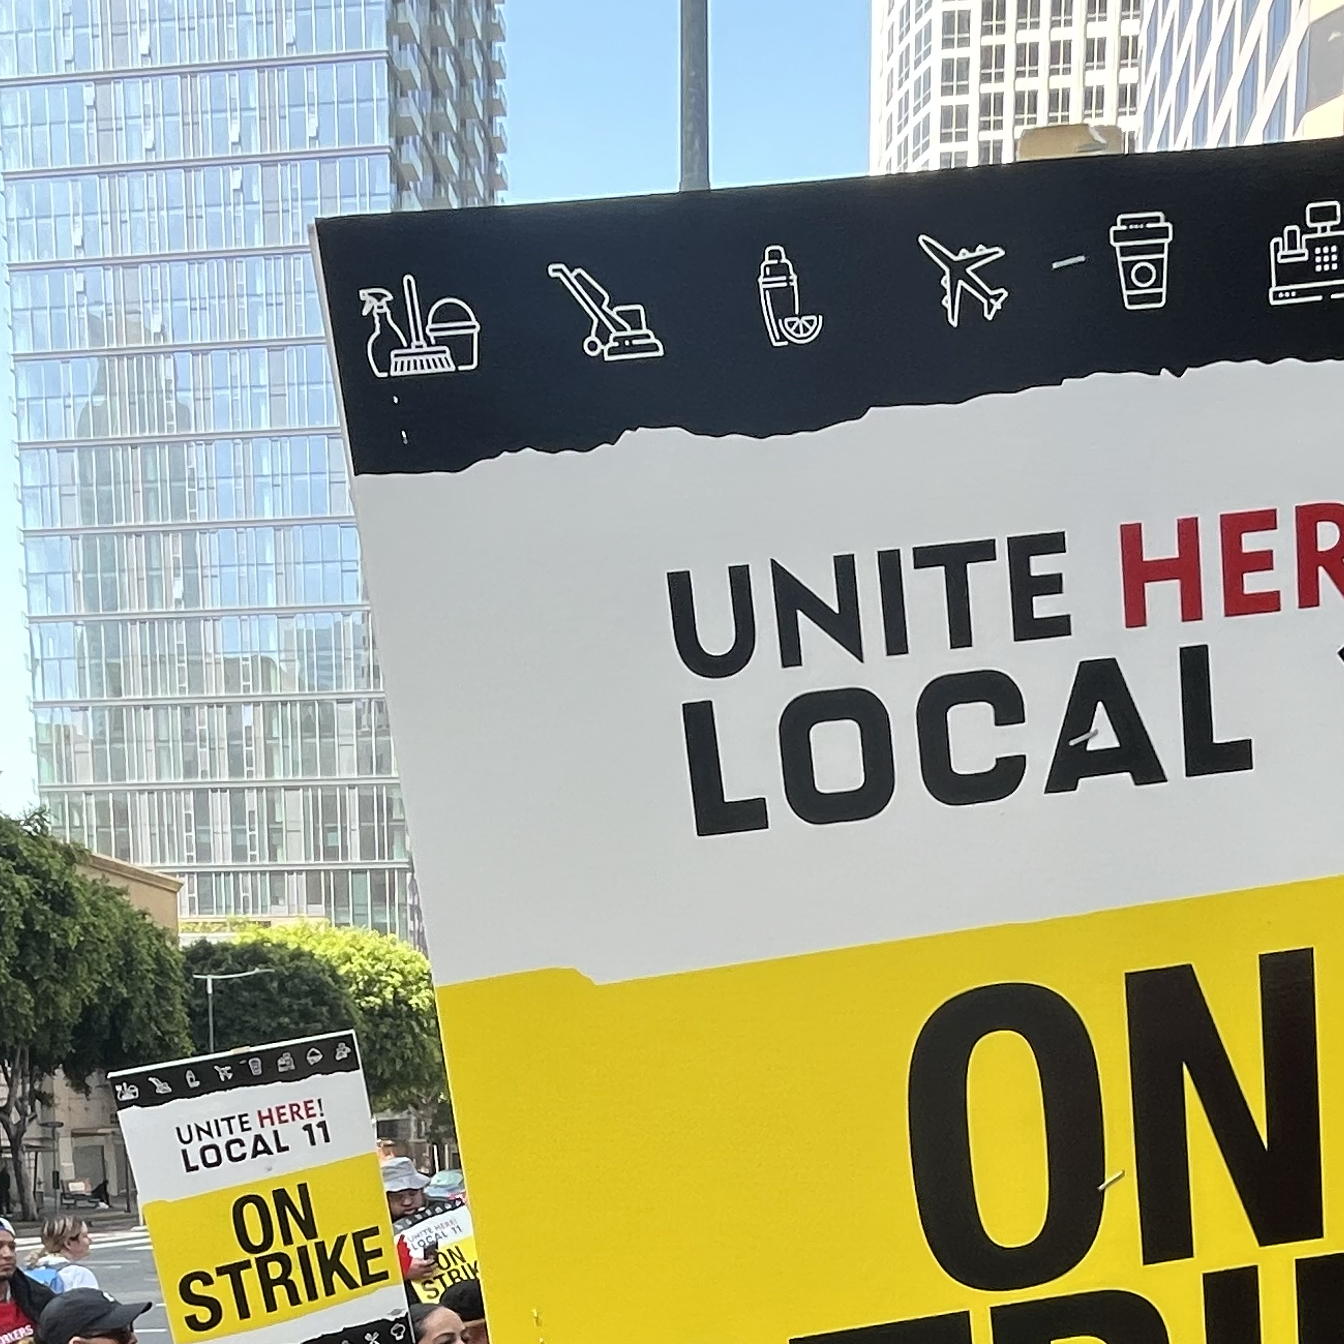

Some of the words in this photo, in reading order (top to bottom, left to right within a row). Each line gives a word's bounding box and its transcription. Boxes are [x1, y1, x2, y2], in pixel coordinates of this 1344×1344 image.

[666, 529, 1072, 679] UNITE
[681, 643, 1253, 838] LOCAL
[175, 1112, 252, 1146] UNITE
[257, 1098, 325, 1129] HERE!
[181, 1133, 290, 1174] LOCAL
[302, 1120, 332, 1147] 11
[906, 945, 1325, 1293] ON
[231, 1182, 319, 1255] ON
[178, 1225, 390, 1332] STRIKE
[421, 1260, 480, 1300] STRIK
[436, 1245, 467, 1271] ON
